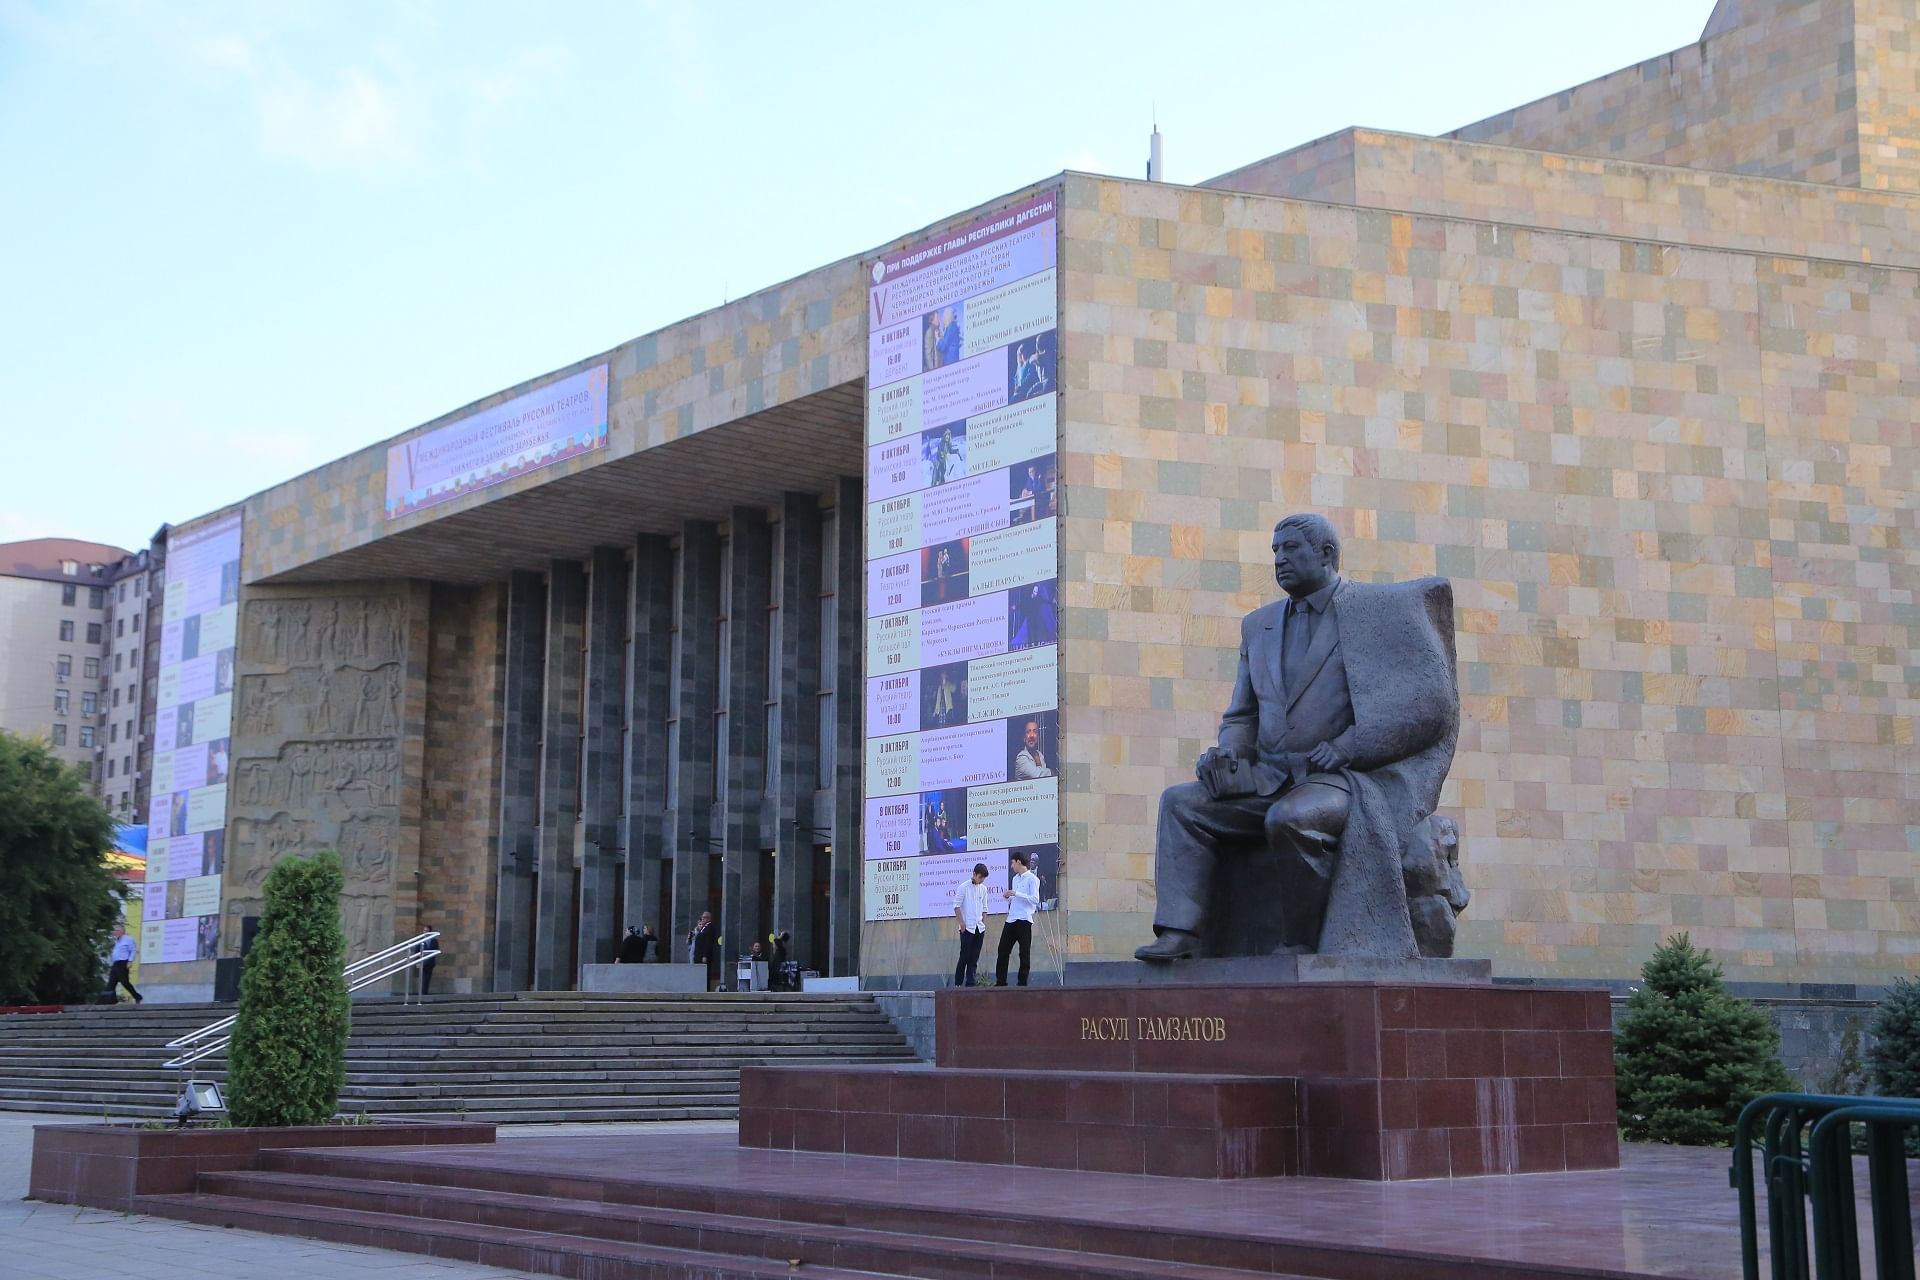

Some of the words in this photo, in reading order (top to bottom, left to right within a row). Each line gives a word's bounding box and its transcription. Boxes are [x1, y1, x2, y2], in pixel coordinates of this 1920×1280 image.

[886, 261, 899, 274] ПРИ
[901, 245, 941, 268] ПОДДЕРЖКЕ
[944, 235, 966, 252] ГЛАВЫ
[968, 216, 1014, 241] РЕСПУБЛИКИ
[1016, 201, 1052, 222] ДАГЕСТАН
[945, 253, 977, 271] ФЕСТИВАЛЬ
[980, 242, 1007, 258] РУССКИХ
[1009, 231, 1035, 247] ТЕАТРОВ
[991, 250, 1009, 263] СТРАН
[873, 288, 887, 326] V
[556, 391, 589, 412] ТЕАТРОВ
[886, 497, 910, 513] ОКТЯБРЯ
[886, 563, 909, 578] ОКТЯБРЯ
[885, 615, 908, 629] ОКТЯБРЯ
[885, 677, 908, 690] ОКТЯБРЯ
[885, 740, 908, 753] ОКТЯБРЯ
[884, 804, 908, 816] ОКТЯБРЯ
[882, 860, 906, 872] ОКТЯБРЯ
[1080, 1017, 1130, 1040] РАСУЛ
[1137, 1016, 1226, 1042] ГАМЗАТОВ
